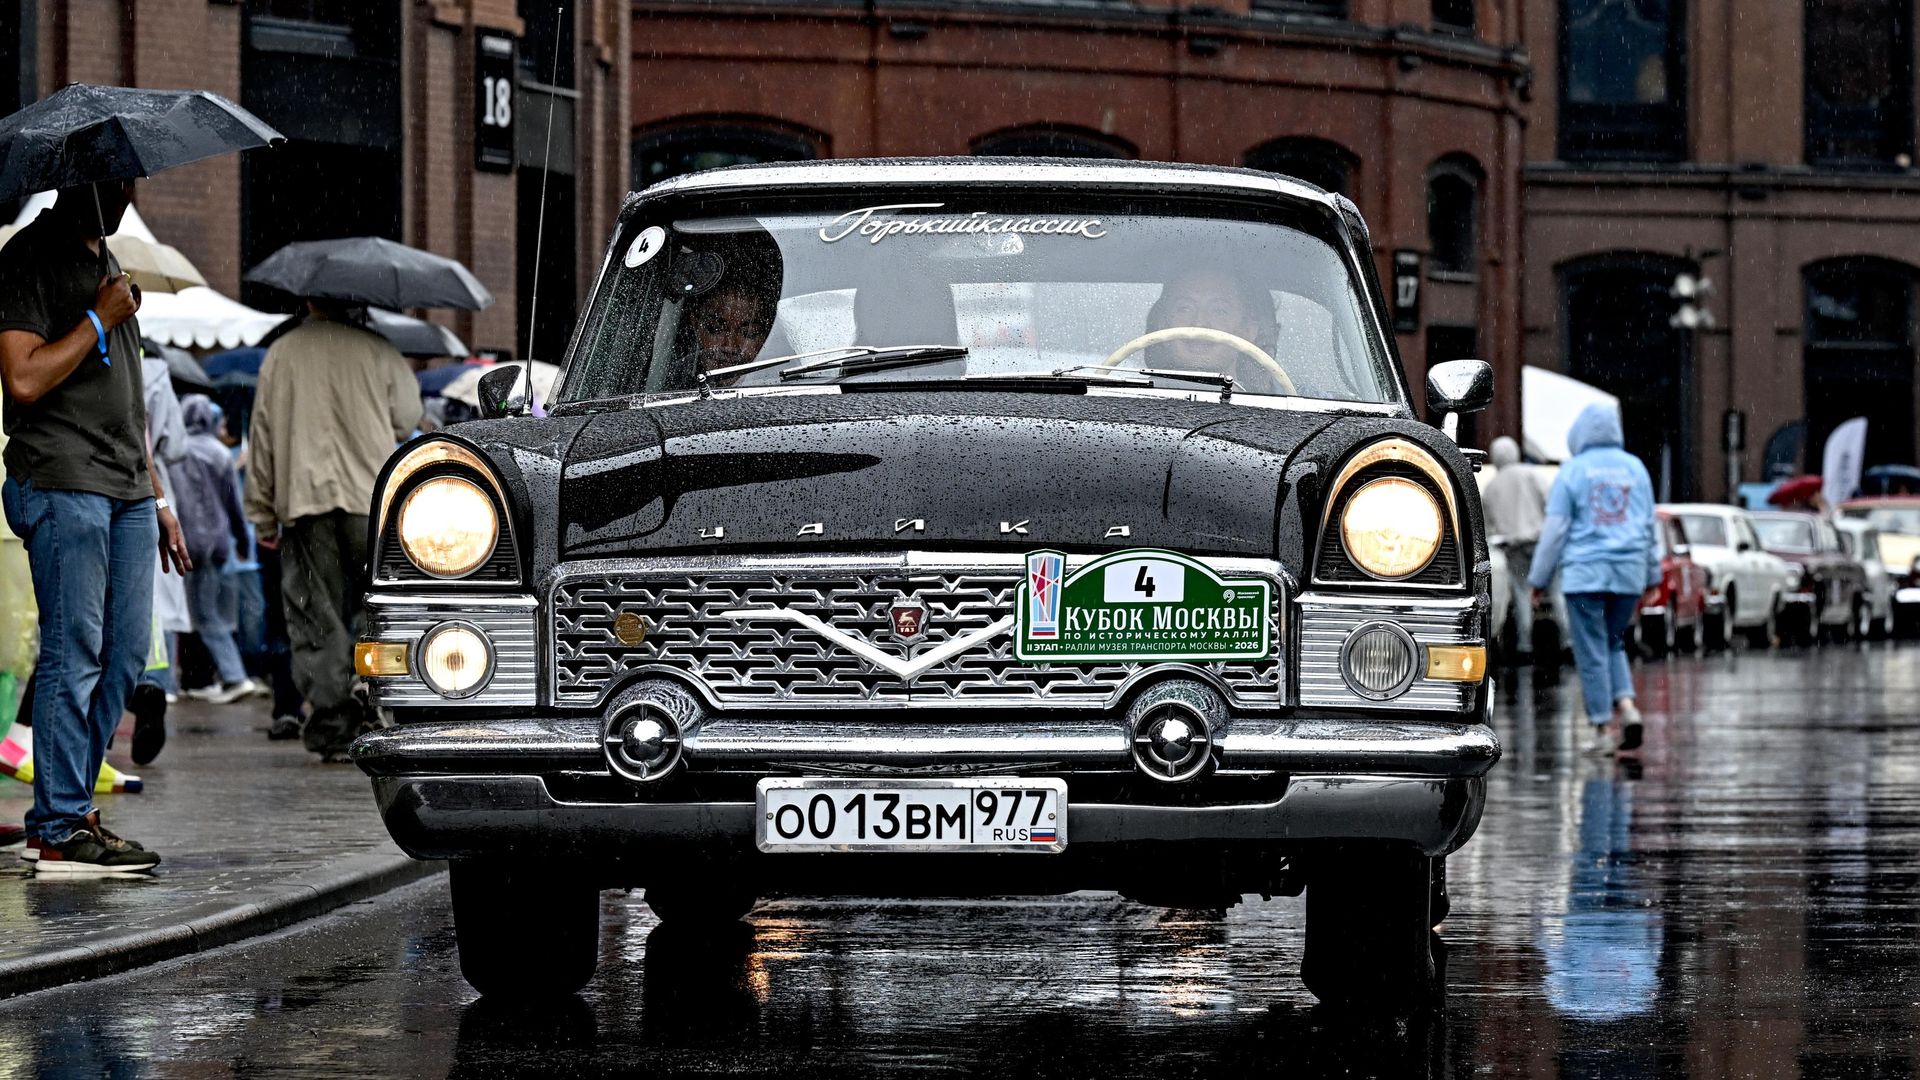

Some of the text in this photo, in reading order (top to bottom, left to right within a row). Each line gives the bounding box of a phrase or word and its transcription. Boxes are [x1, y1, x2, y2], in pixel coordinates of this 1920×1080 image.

[483, 76, 511, 128] 18
[638, 237, 649, 253] 4
[1134, 565, 1156, 598] 4
[1064, 630, 1259, 640] ПО ИСТОРИЧЕСКОМУ РАЛЛИ
[1033, 643, 1058, 652] ЭТАП
[1065, 643, 1096, 652] РАЛЛИ
[1098, 643, 1128, 651] МУЗЕЯ
[1131, 642, 1187, 651] ТРАНСПОРТА
[1189, 641, 1227, 650] МОСКВЫ
[1234, 641, 1259, 650] 2026
[975, 790, 1048, 827] 977
[993, 828, 1029, 841] RUS
